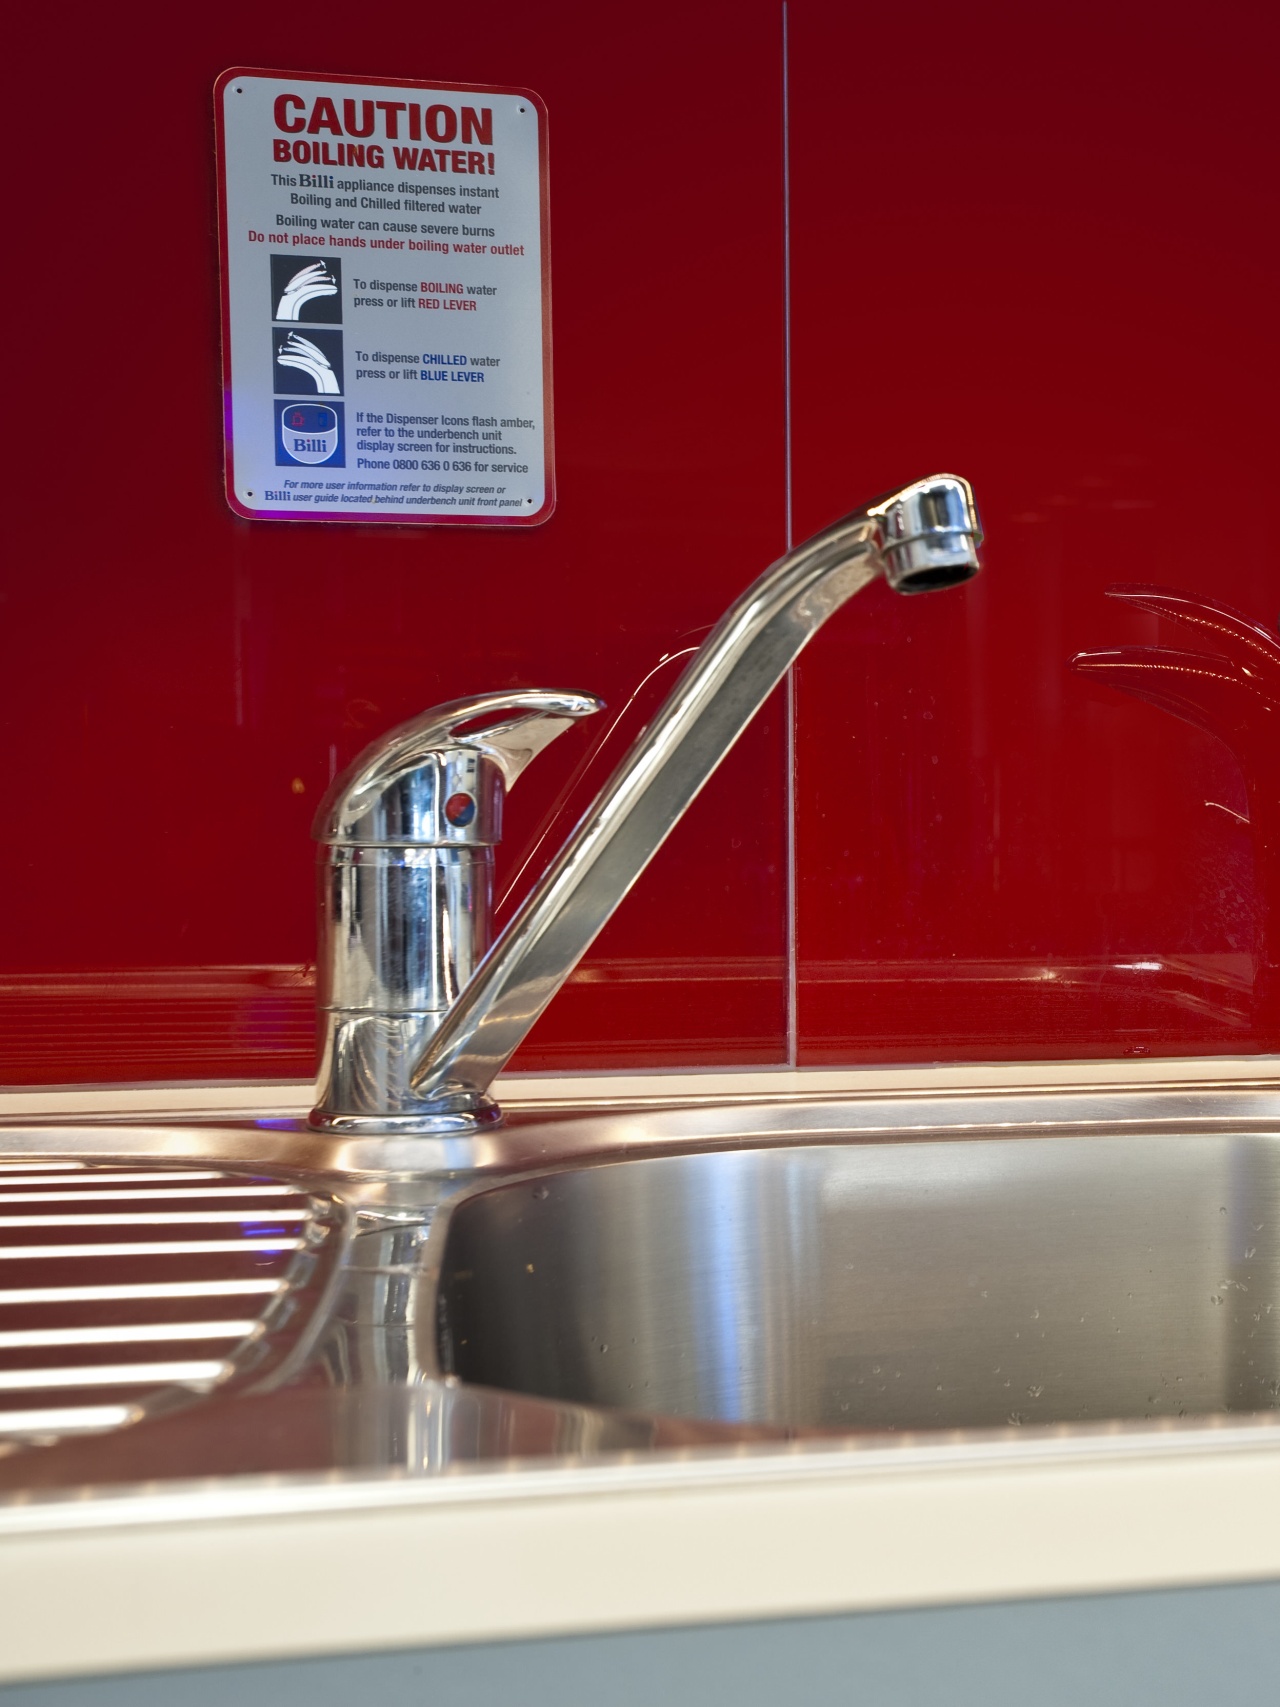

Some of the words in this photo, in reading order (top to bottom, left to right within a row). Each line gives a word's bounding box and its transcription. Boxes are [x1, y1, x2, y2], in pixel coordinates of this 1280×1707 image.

[273, 93, 493, 145] CAUTION
[272, 138, 384, 169] BOILING
[393, 147, 495, 175] WATER!
[271, 174, 297, 186] This
[299, 174, 334, 189] Billi
[337, 180, 394, 193] appliance
[398, 182, 456, 196] dispenses
[459, 185, 499, 198] instant
[290, 194, 331, 208] Boiling
[335, 196, 358, 207] and
[360, 197, 400, 210] Chilled
[404, 200, 445, 212] filtered
[448, 204, 482, 215] water
[276, 214, 317, 229] Boiling
[321, 218, 355, 230] water
[358, 220, 380, 231] can
[383, 221, 418, 233] cause
[421, 223, 458, 235] severe
[462, 224, 495, 237] burns
[248, 231, 265, 242] Do
[269, 232, 289, 243] not
[292, 234, 325, 247] place
[329, 235, 366, 248] hands
[370, 237, 406, 249] under
[409, 239, 449, 254] boiling
[453, 243, 487, 254] water
[491, 244, 524, 256] outlet
[354, 279, 366, 291] To
[369, 280, 417, 294] dispense
[420, 282, 464, 294] BOILING
[466, 285, 497, 296] water
[354, 299, 384, 310] press
[387, 298, 398, 308] or
[401, 297, 416, 309] lift
[418, 299, 440, 310] RED
[443, 300, 477, 311] LEVER
[356, 351, 368, 362] To
[372, 352, 419, 366] dispense
[422, 354, 467, 365] CHILLED
[470, 356, 500, 367] water
[356, 370, 386, 381] press
[389, 370, 400, 379] or
[403, 369, 418, 380] lift
[420, 370, 448, 381] BLUE
[451, 372, 484, 383] LEVER
[356, 413, 363, 423] If
[366, 414, 383, 424] the
[386, 414, 438, 428] Dispenser
[441, 415, 469, 426] Icons
[472, 416, 497, 428] flash
[501, 417, 535, 429] amber,
[356, 428, 381, 437] refer
[384, 428, 395, 438] to
[398, 429, 414, 439] the
[417, 429, 479, 440] underbench
[482, 431, 502, 441] unit
[294, 438, 327, 453] Billi
[356, 440, 394, 453] display
[397, 443, 433, 452] screen
[435, 442, 450, 453] for
[453, 443, 517, 454] instructions.
[357, 459, 390, 470] Phone
[393, 459, 418, 470] 0800
[421, 461, 440, 471] 636
[443, 461, 450, 471] 0
[453, 462, 471, 472] 636
[474, 462, 488, 472] for
[491, 463, 528, 473] service
[284, 480, 299, 489] For
[348, 482, 397, 491] information
[400, 483, 420, 492] refer
[423, 484, 431, 492] to
[434, 485, 463, 495] display
[466, 486, 494, 494] screen
[265, 491, 290, 501] Billi
[293, 494, 311, 502] user
[314, 494, 338, 505] guide
[341, 495, 372, 503] located
[375, 495, 403, 504] behind
[406, 496, 456, 505] underbench
[458, 497, 475, 506] unit
[478, 498, 497, 506] front
[499, 498, 522, 508] panel
